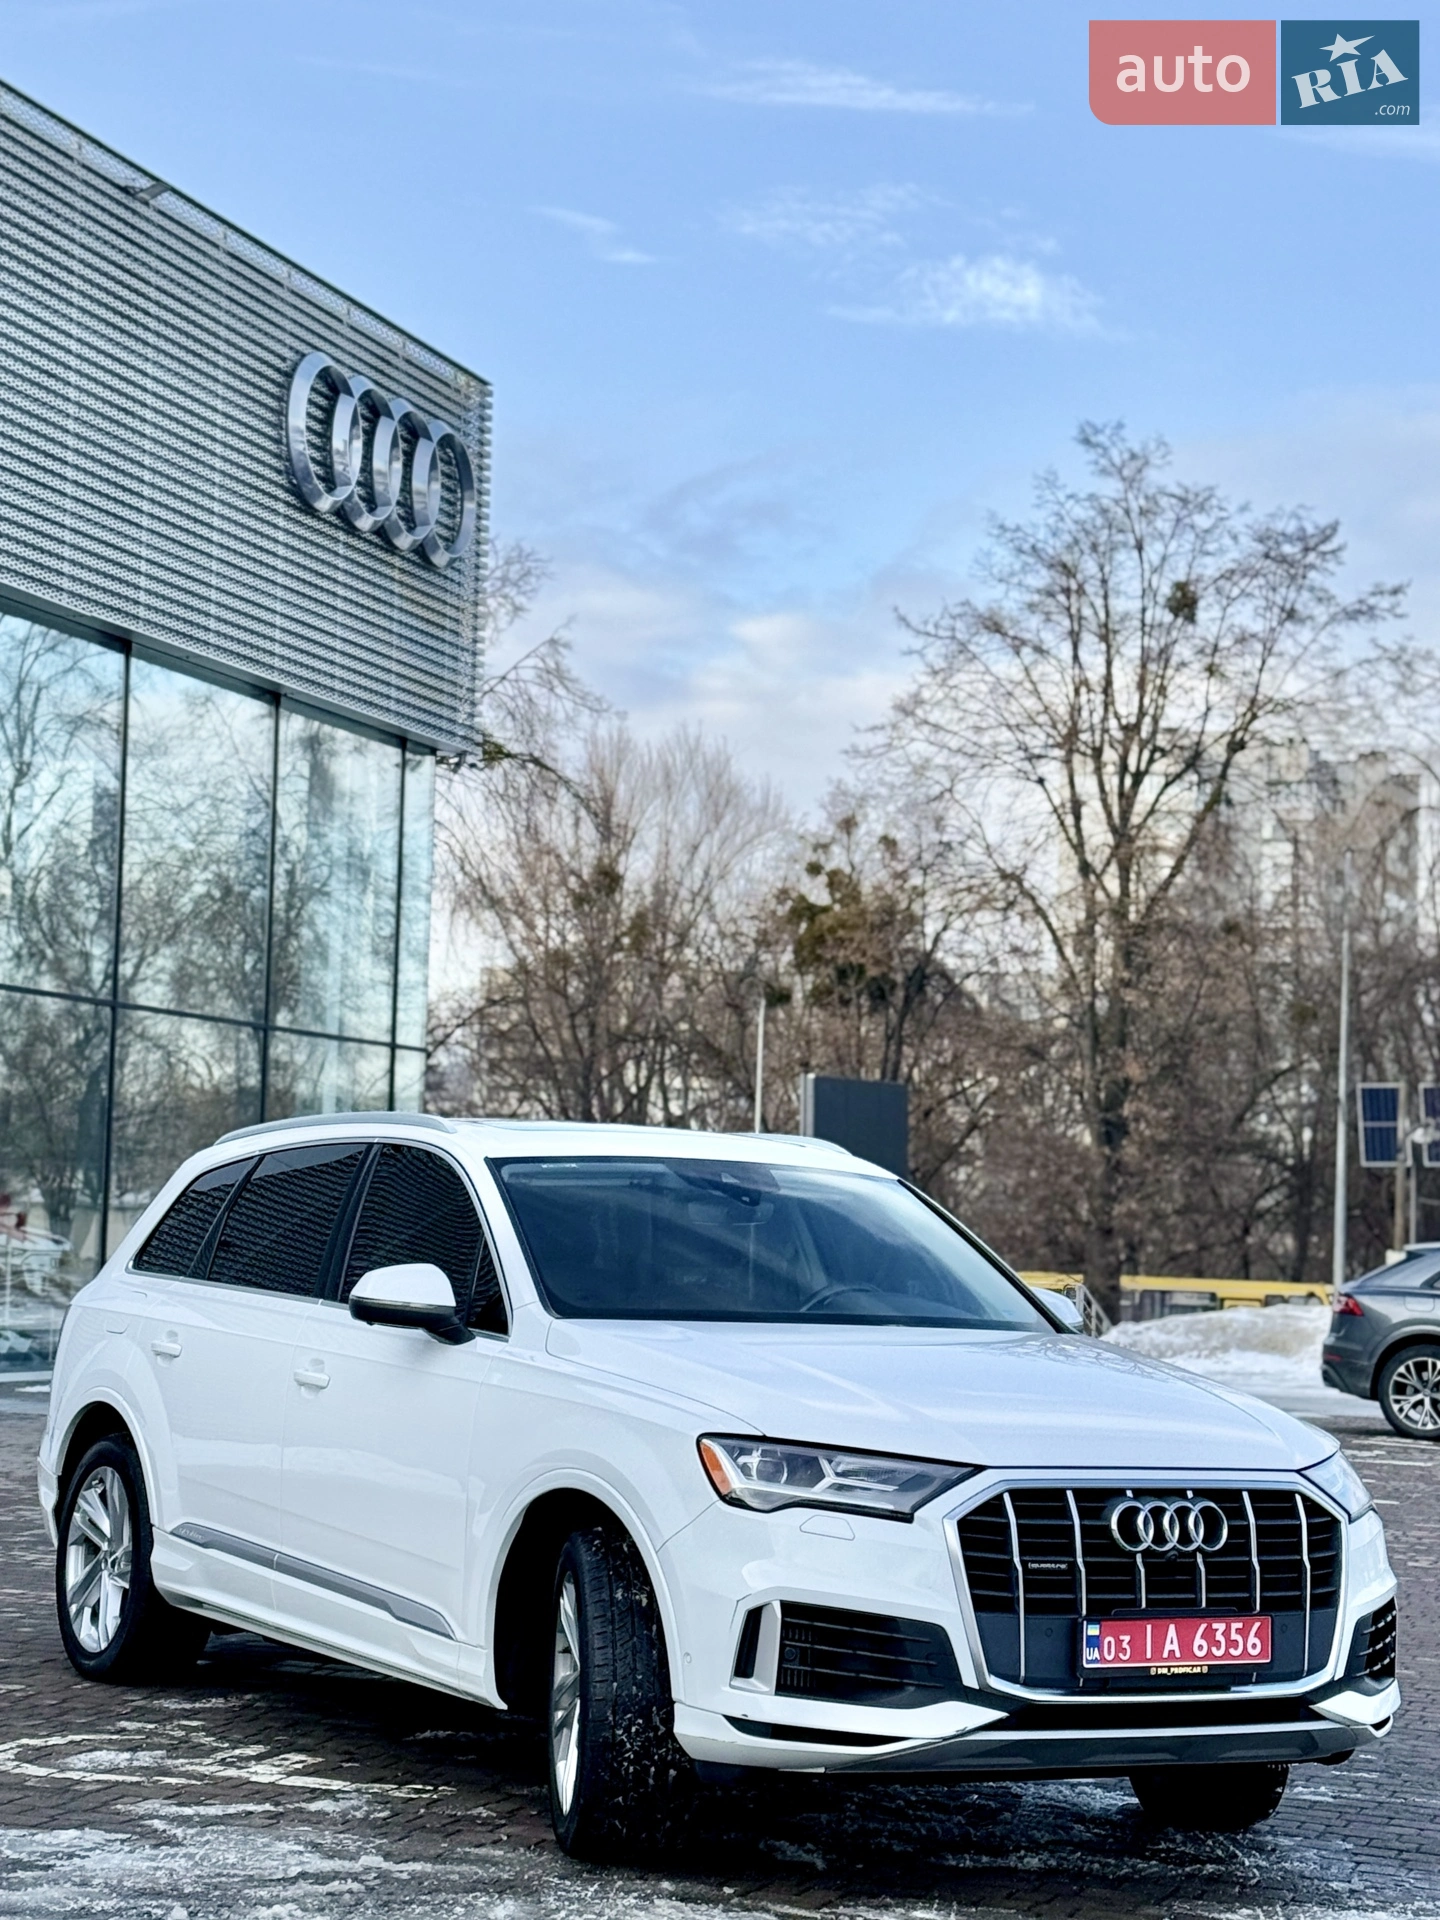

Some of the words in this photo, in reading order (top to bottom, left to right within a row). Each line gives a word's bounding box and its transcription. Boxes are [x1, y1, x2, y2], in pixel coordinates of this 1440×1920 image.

[1086, 1647, 1100, 1661] UA
[1103, 1634, 1131, 1661] 03
[1146, 1623, 1181, 1659] IA
[1193, 1621, 1262, 1657] 6356
